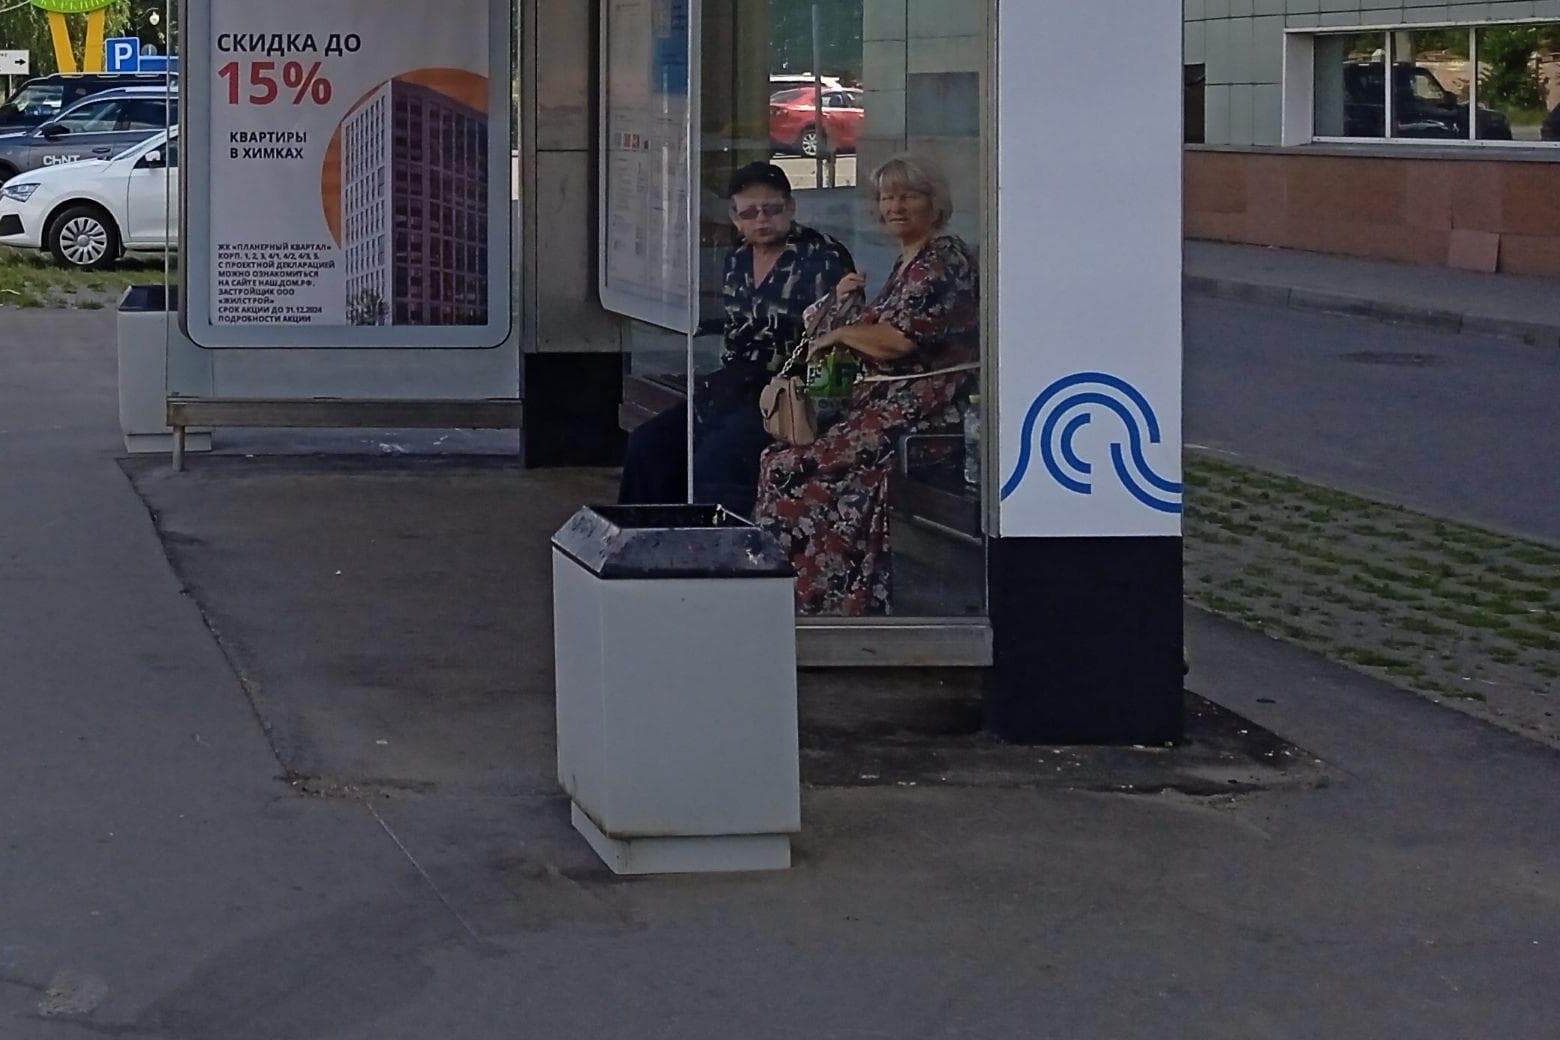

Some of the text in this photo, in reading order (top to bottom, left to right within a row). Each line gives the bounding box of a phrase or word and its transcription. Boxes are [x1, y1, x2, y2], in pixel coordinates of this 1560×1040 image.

[217, 33, 362, 57] СКИДКА ДО
[114, 43, 133, 70] P
[217, 61, 332, 105] 15%
[229, 131, 307, 143] КВАРТИРЫ
[230, 147, 304, 159] В ХИМКАХ
[225, 261, 275, 269] ПРОЕКТНОЙ
[276, 260, 335, 269] ДЕКЛАРАЦИЕЙ
[231, 278, 256, 286] САЙТЕ
[218, 287, 275, 296] ЗАСТРОЙЩИК
[241, 306, 270, 315] АКЦИИ
[271, 306, 284, 314] ДО
[218, 315, 312, 323] ПОДРОБНОСТИ АКЦИИ
